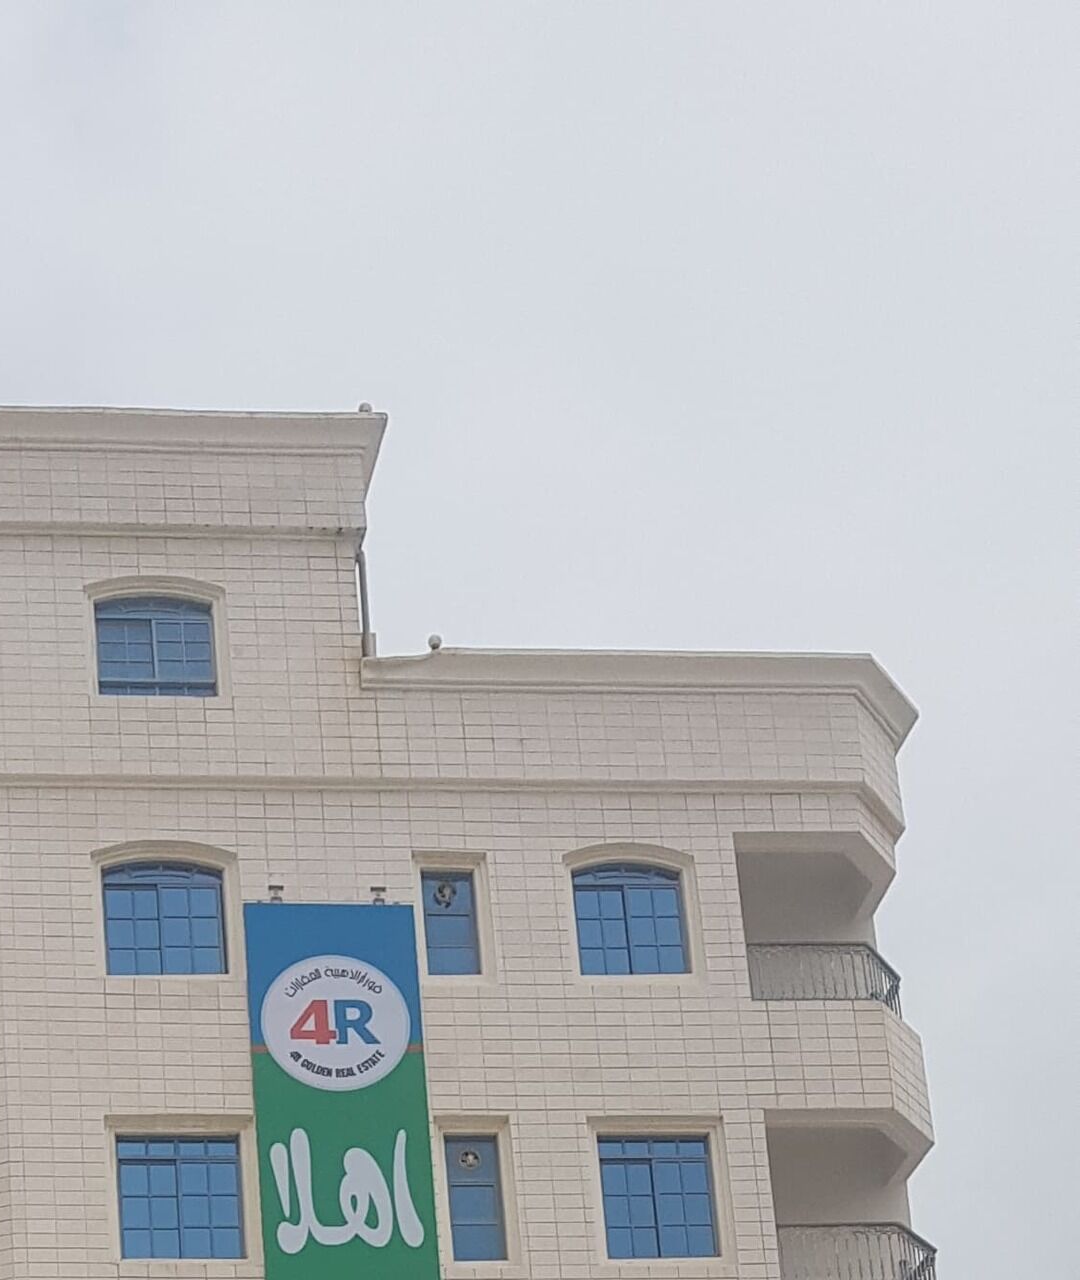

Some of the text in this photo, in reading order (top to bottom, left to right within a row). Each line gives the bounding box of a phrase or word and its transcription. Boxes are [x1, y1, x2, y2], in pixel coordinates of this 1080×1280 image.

[290, 999, 381, 1045] 4R
[300, 1058, 333, 1078] GOLDEN
[335, 1067, 357, 1078] REAL
[356, 1049, 385, 1074] ESTATE
